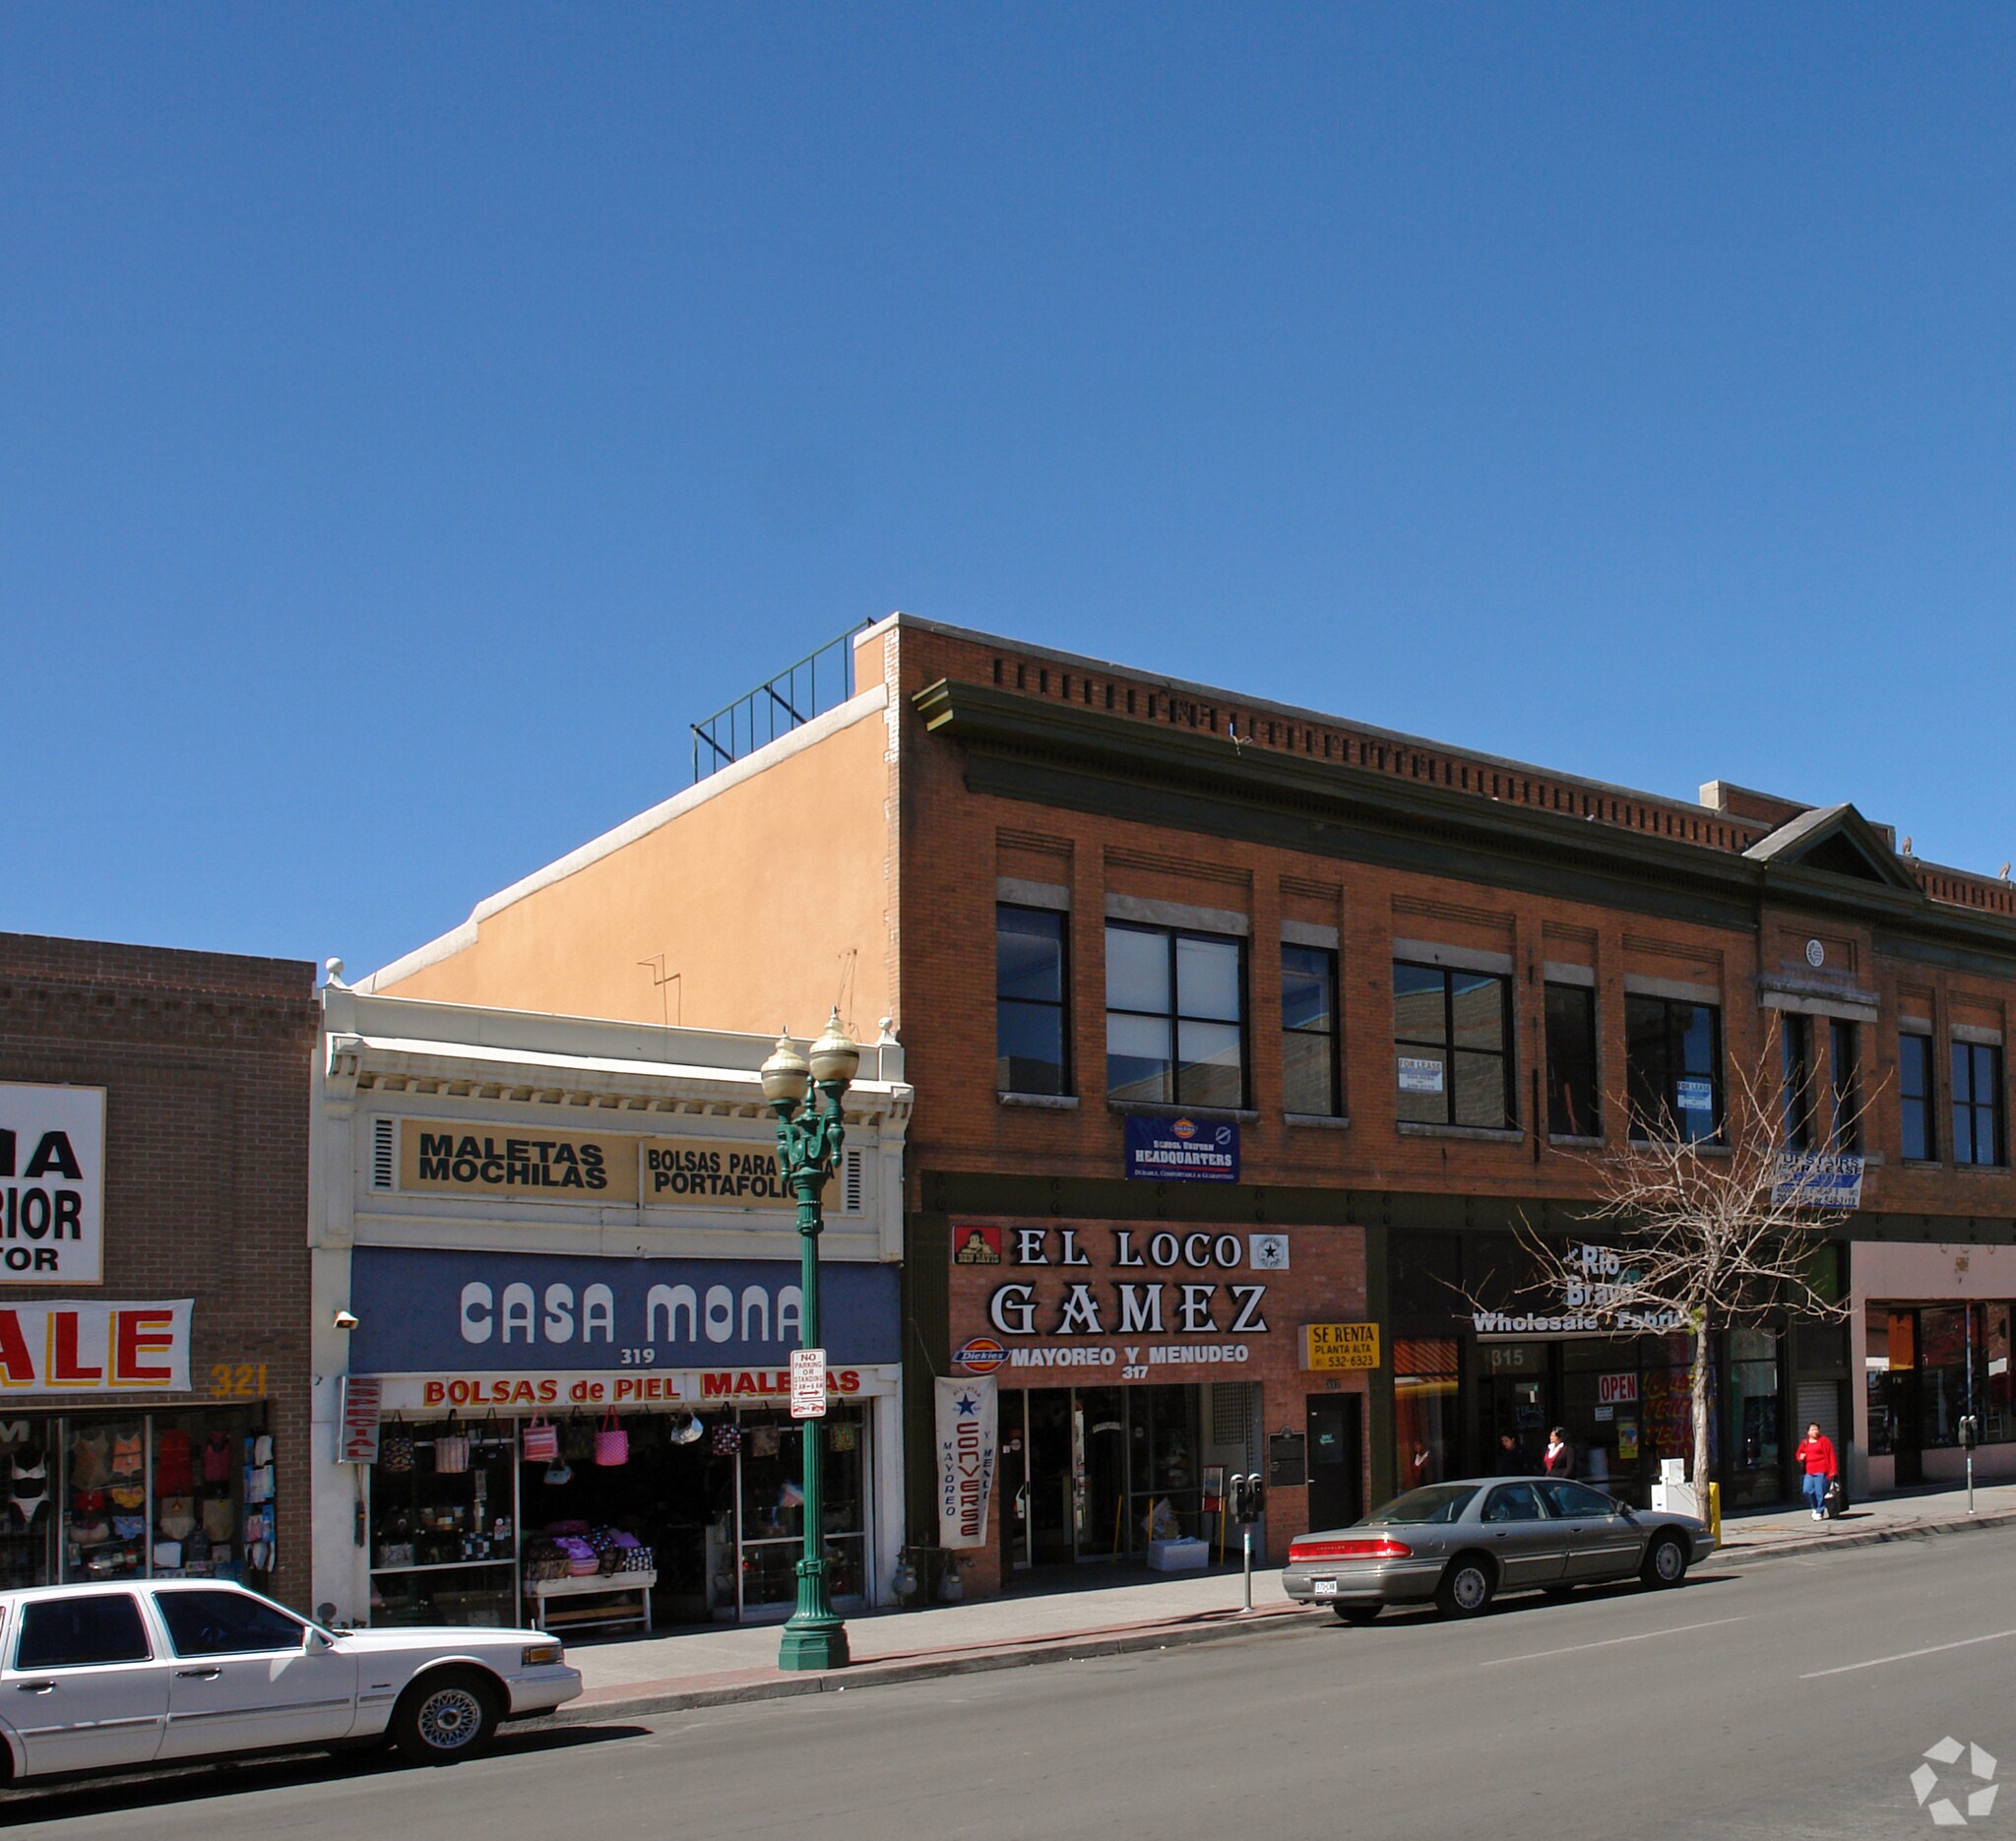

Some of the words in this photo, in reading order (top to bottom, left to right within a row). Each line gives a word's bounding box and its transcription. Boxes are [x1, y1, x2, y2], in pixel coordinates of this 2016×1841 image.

[1400, 1059, 1415, 1068] FOR
[419, 1132, 604, 1167] MALETAS
[648, 1149, 721, 1174] BOLSAS
[729, 1153, 777, 1176] PARA
[1135, 1150, 1232, 1167] HEADQUARTERS
[419, 1157, 607, 1189] MOCHILAS
[0, 1187, 82, 1239] IOR
[0, 1246, 59, 1271] OR
[1017, 1230, 1089, 1265] EL
[1115, 1232, 1243, 1268] LOCO
[1582, 1244, 1620, 1275] Rio
[461, 1282, 614, 1344] CASA
[990, 1283, 1269, 1334] GAMEZ
[1473, 1311, 1599, 1331] Wholesale
[1313, 1327, 1329, 1343] SE
[1335, 1325, 1374, 1343] RENTA
[620, 1349, 656, 1365] 319
[800, 1353, 816, 1362] NO
[961, 1351, 1004, 1361] Dickies
[1010, 1347, 1116, 1367] MAYOREO
[1124, 1347, 1140, 1365] Y
[1148, 1345, 1249, 1365] MENUDEO
[1315, 1345, 1350, 1355] PLANTA
[1353, 1343, 1371, 1353] ALTA
[1329, 1355, 1373, 1366] 532-6323
[1492, 1349, 1524, 1366] 315
[211, 1365, 267, 1397] 321
[1121, 1365, 1150, 1379] 317
[423, 1378, 558, 1407] BOLSAS
[569, 1380, 604, 1403] de
[613, 1378, 680, 1401] PIEL
[701, 1370, 860, 1398] MALEAS
[1601, 1374, 1636, 1402] OPEN
[346, 1378, 379, 1457] ESPECIAL
[942, 1441, 956, 1516] MAYOREO
[956, 1422, 980, 1537] CONVERSE
